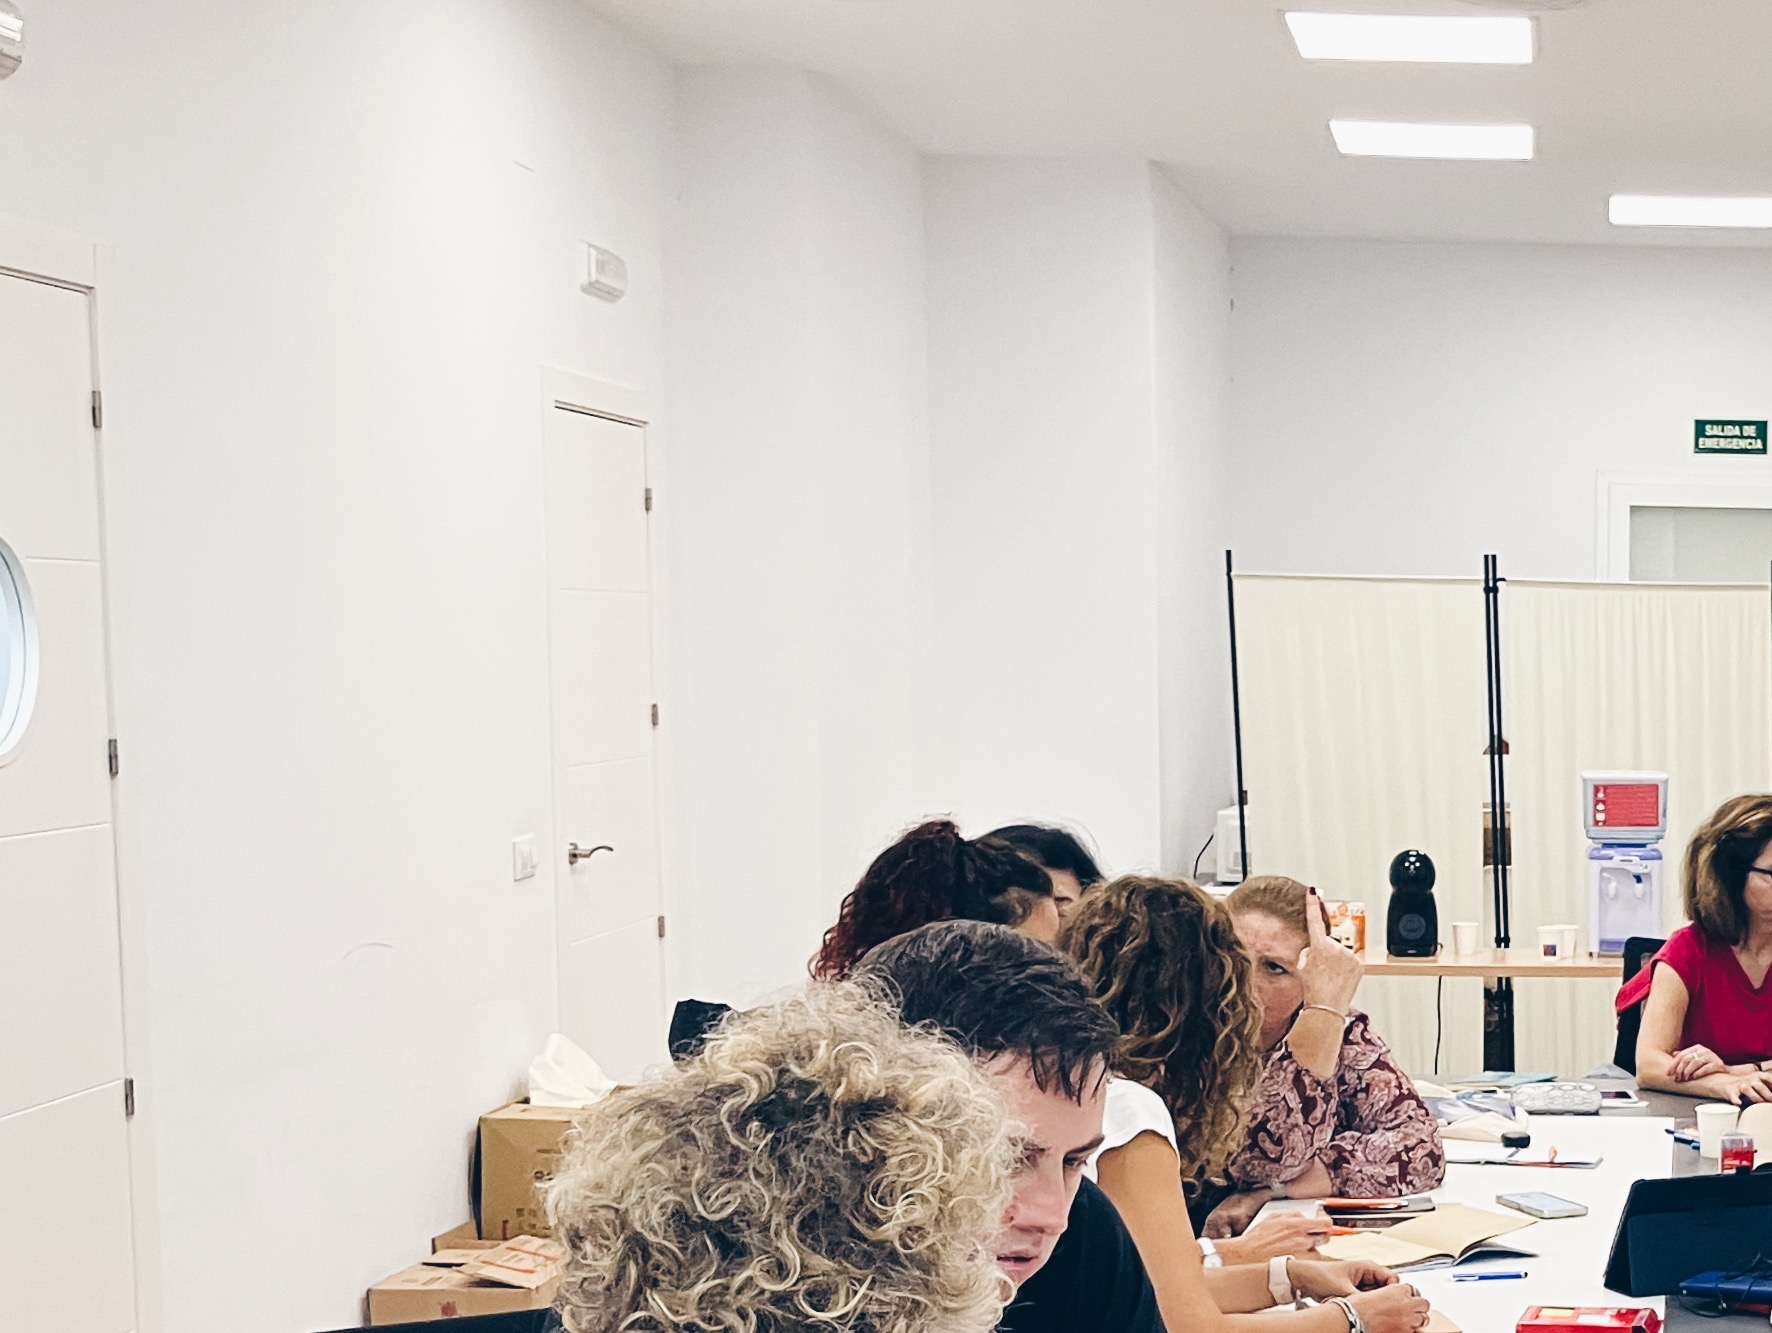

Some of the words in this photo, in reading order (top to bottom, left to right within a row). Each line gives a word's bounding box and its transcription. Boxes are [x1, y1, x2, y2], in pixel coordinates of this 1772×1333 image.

[1704, 424, 1741, 436] SALIDA
[1742, 425, 1757, 437] DE
[1698, 437, 1763, 449] EMERGENCIA
